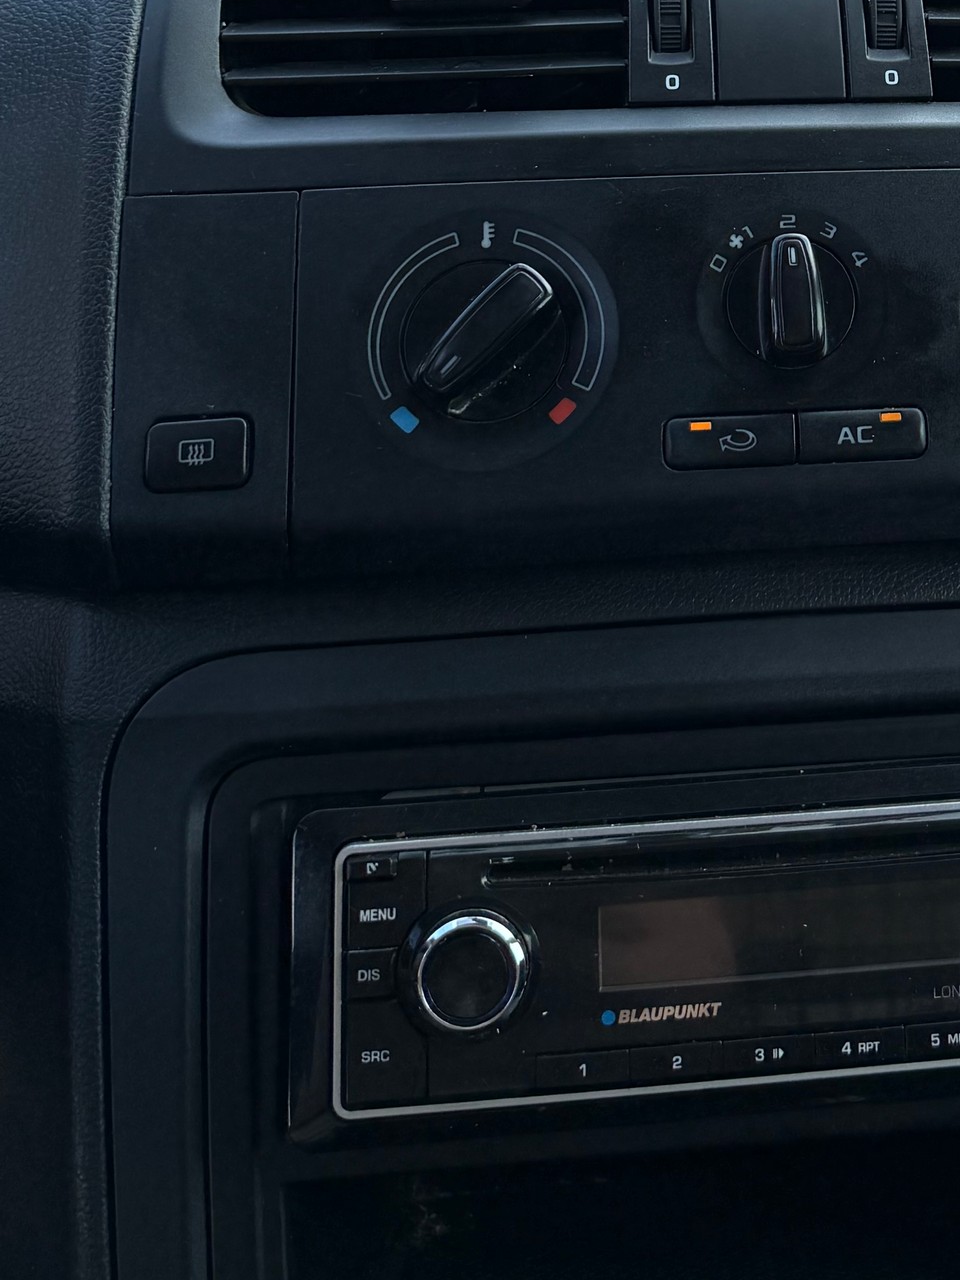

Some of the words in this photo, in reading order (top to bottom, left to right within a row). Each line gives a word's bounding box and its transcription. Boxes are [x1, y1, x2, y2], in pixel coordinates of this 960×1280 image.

[741, 225, 755, 240] 1
[779, 214, 797, 229] 2
[819, 221, 837, 239] 3
[851, 250, 869, 268] 4
[838, 426, 873, 444] AC
[359, 907, 398, 922] MENU
[357, 968, 381, 983] DIS
[618, 1002, 722, 1024] BLAUPUNKT
[930, 1033, 941, 1047] 5
[754, 1048, 765, 1062] 3
[841, 1041, 852, 1055] 4
[858, 1041, 881, 1054] RPT
[361, 1049, 390, 1064] SRC
[672, 1055, 683, 1070] 2
[579, 1063, 587, 1077] 1
